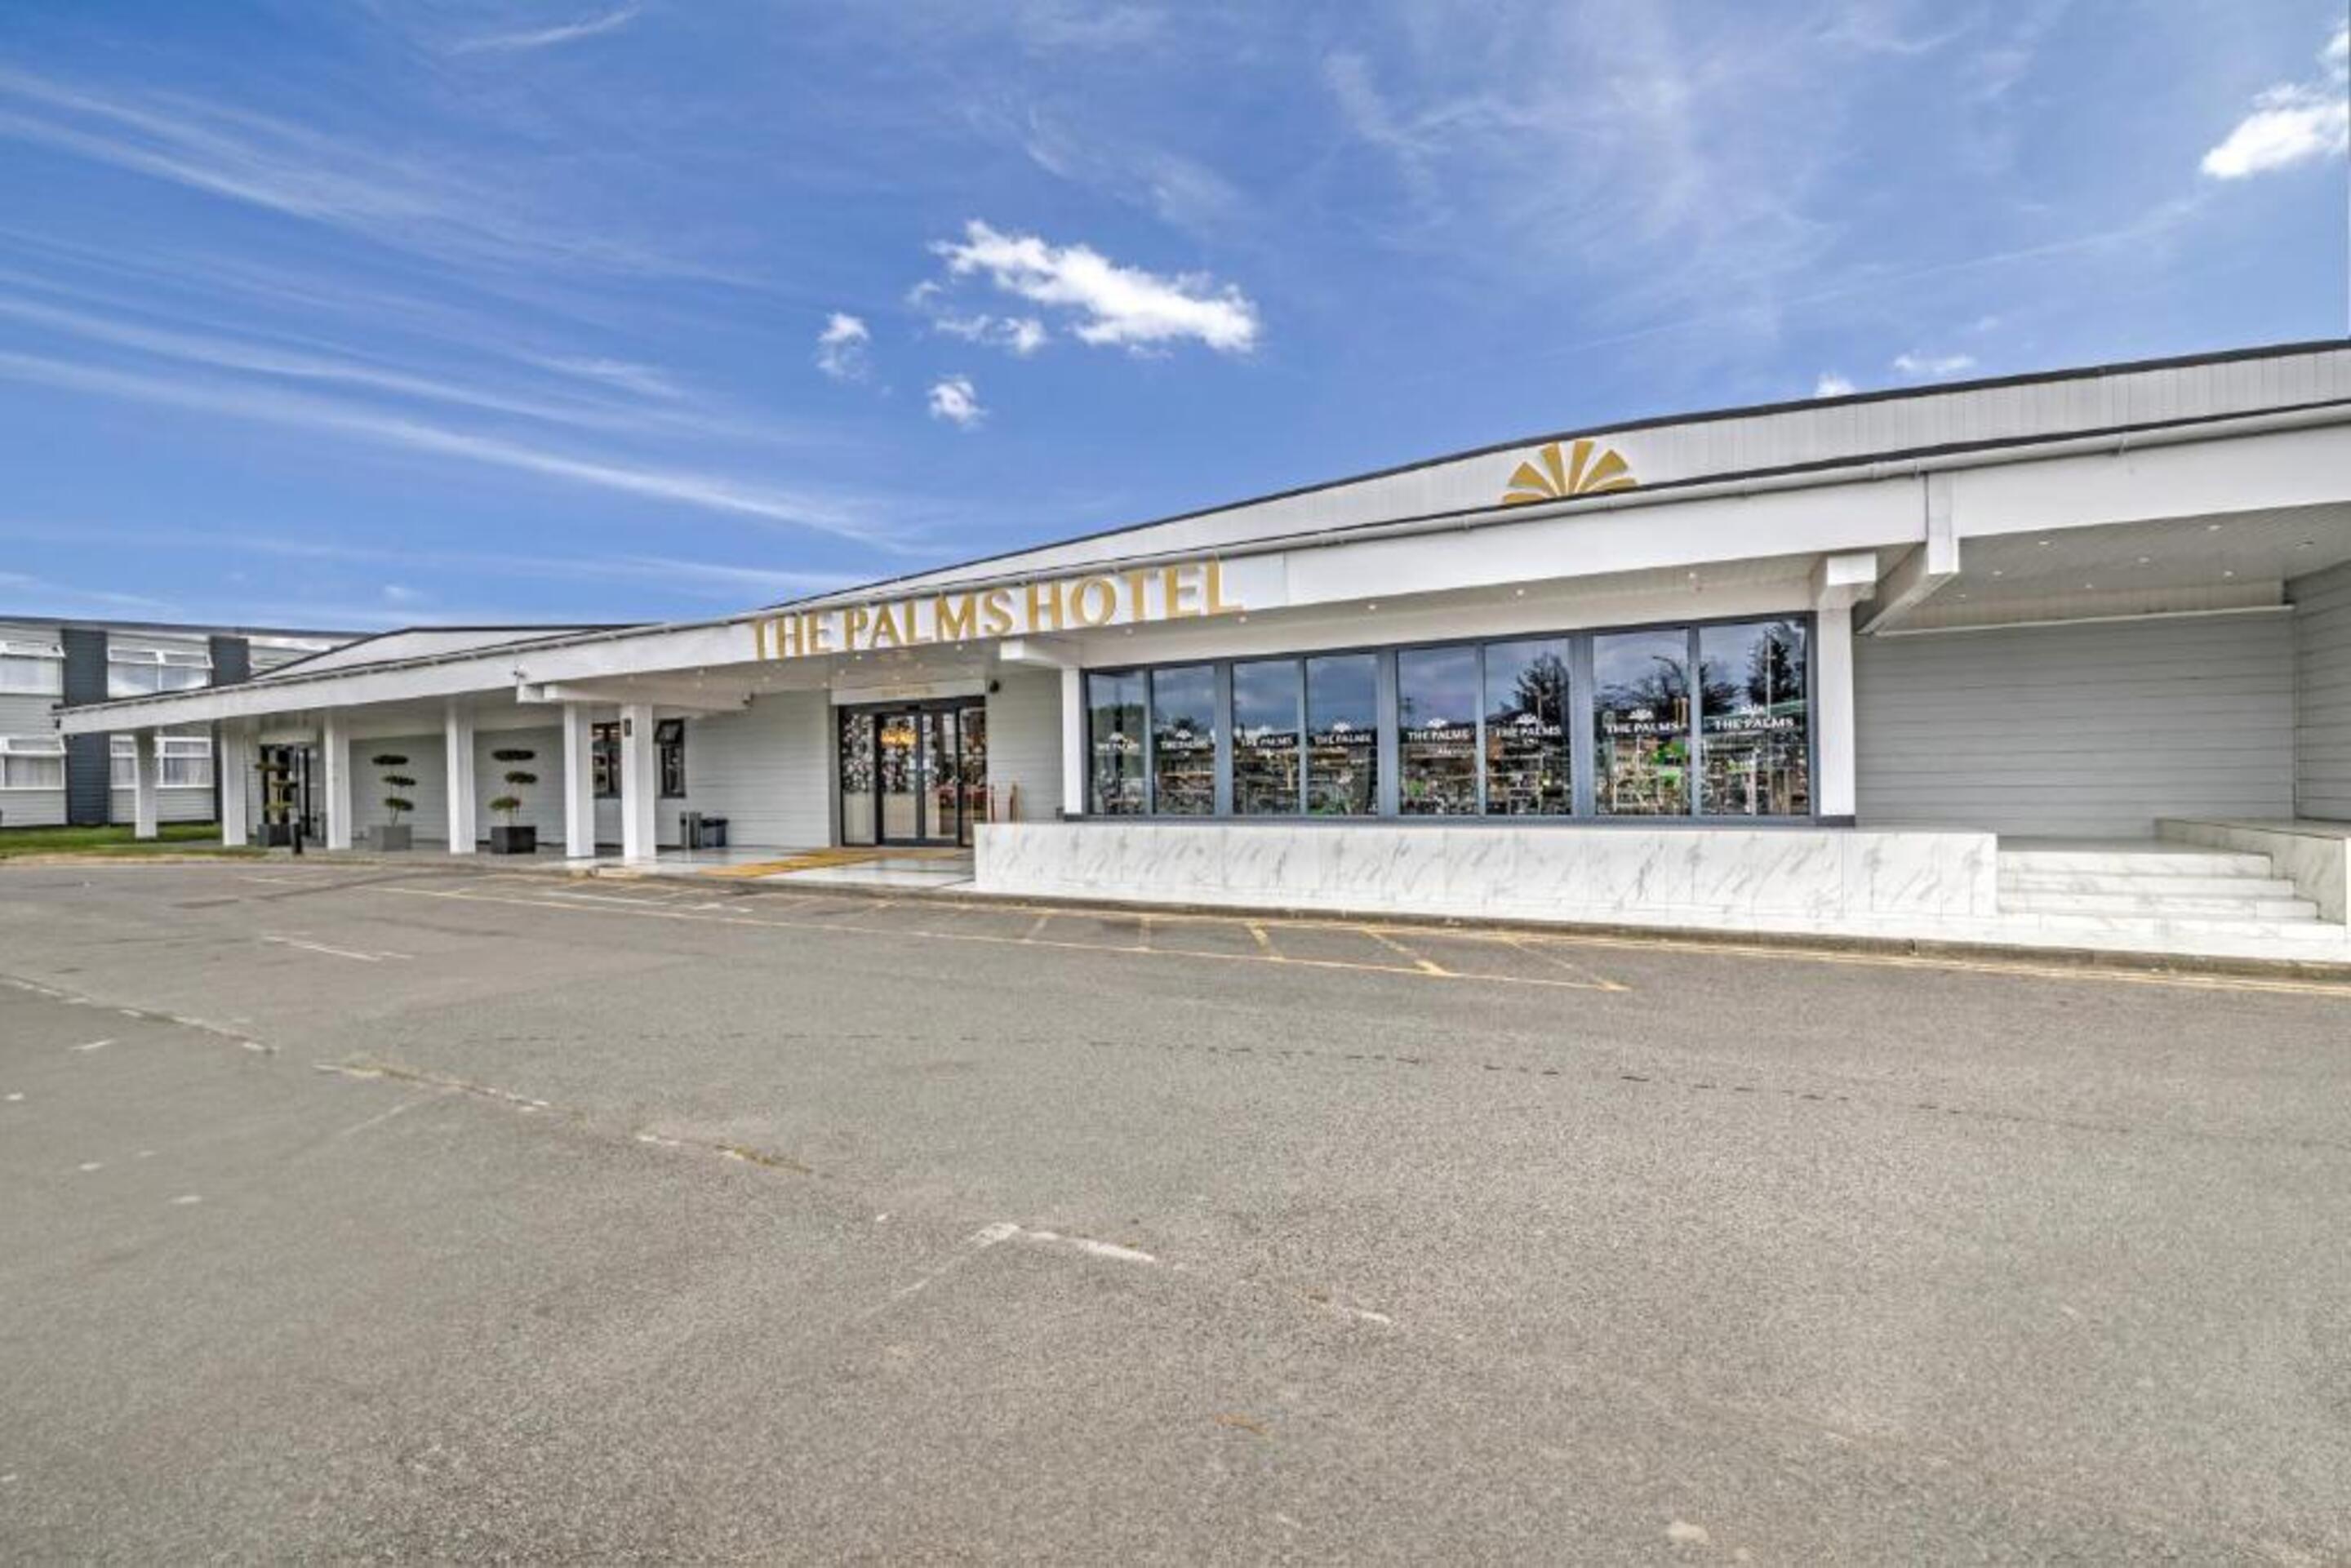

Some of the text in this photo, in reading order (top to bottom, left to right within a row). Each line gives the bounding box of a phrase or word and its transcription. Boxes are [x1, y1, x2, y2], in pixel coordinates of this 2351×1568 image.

[750, 557, 1244, 660] THE PALMS HOTEL
[1606, 722, 1680, 734] THE PALMS
[1713, 717, 1795, 731] THE PALMS
[1407, 730, 1470, 741] THE PALMS
[1521, 726, 1561, 736] PALMS
